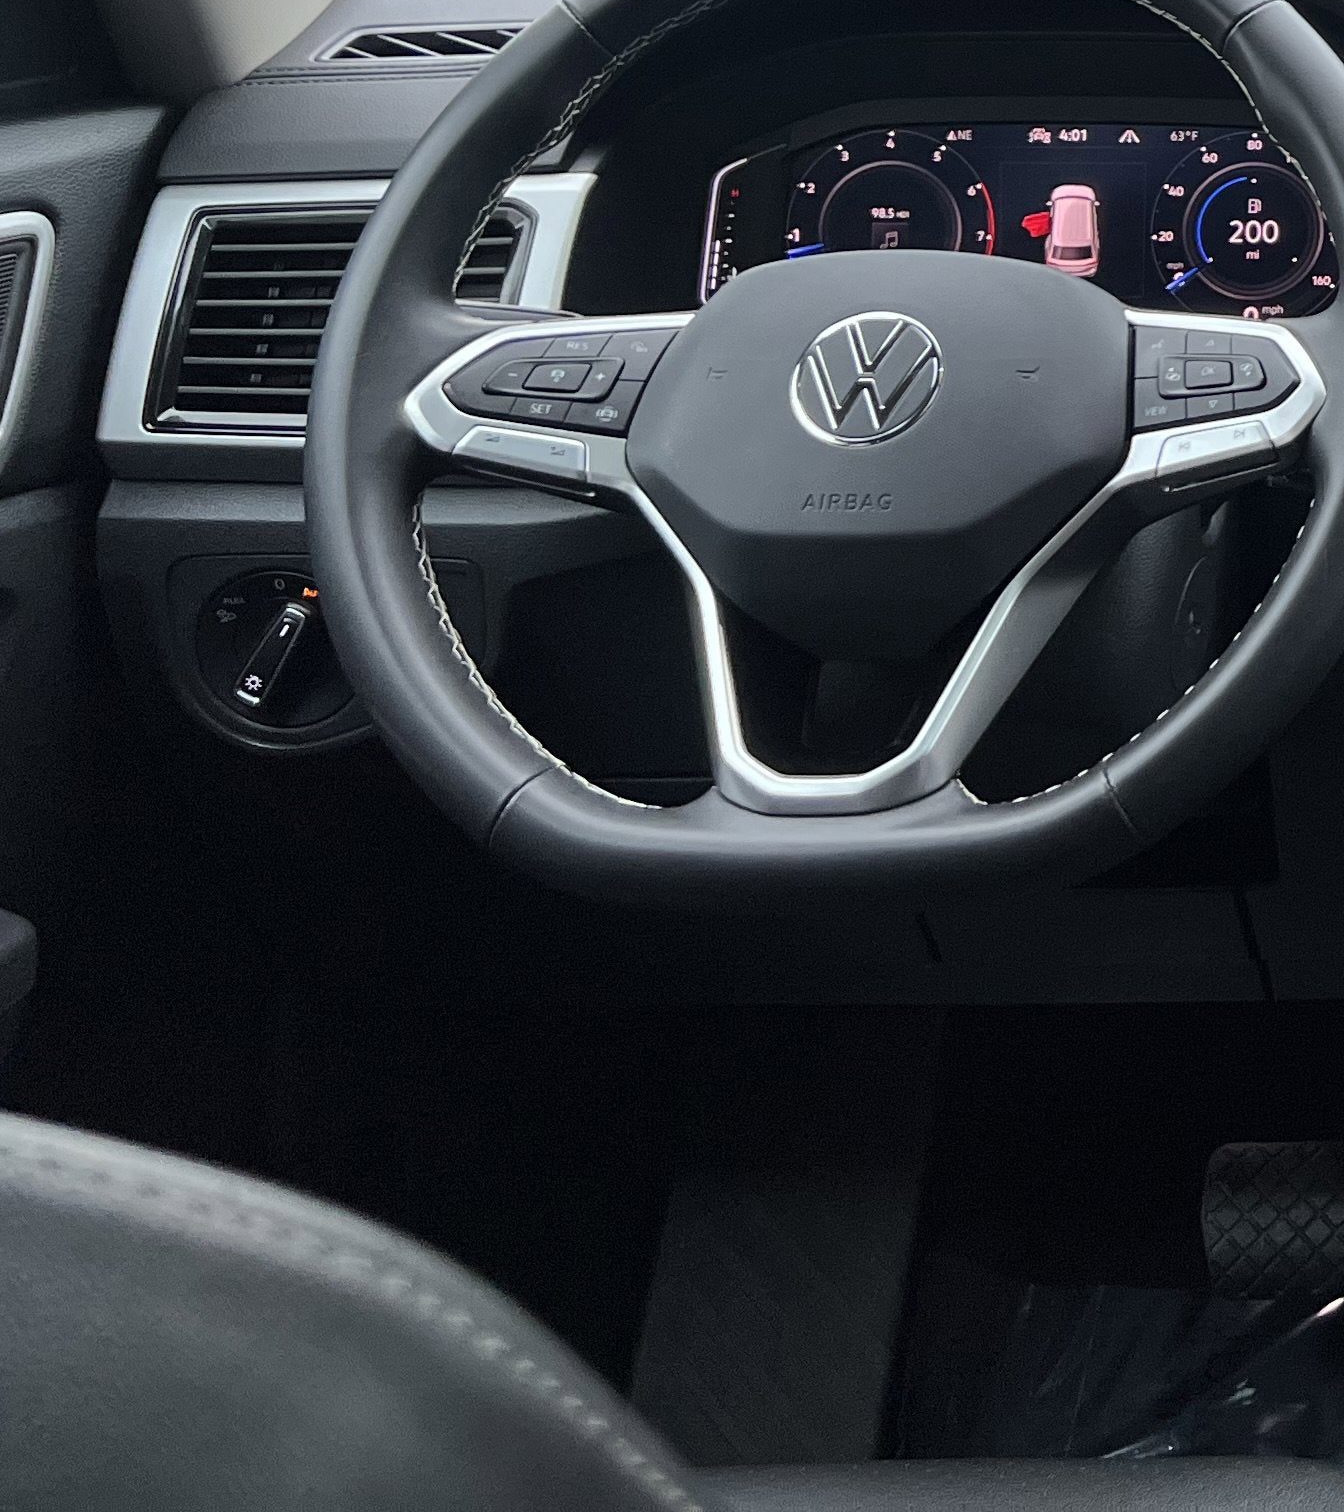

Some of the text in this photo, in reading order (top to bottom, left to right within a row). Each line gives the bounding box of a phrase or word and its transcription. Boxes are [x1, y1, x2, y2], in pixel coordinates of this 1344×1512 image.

[957, 129, 973, 140] NE
[1058, 128, 1087, 141] 4:01
[1170, 130, 1198, 141] 63°F
[886, 138, 895, 149] 4
[1246, 140, 1263, 151] 80
[840, 150, 849, 161] 3
[931, 150, 942, 162] 5
[1201, 152, 1218, 163] 60
[807, 182, 816, 194] 2
[966, 185, 977, 196] 6
[1167, 185, 1185, 197] 40
[871, 207, 895, 219] 98.5
[976, 230, 985, 242] 7
[1158, 231, 1174, 242] 20
[1228, 220, 1279, 244] 200
[1245, 249, 1260, 260] mi
[1311, 275, 1332, 286] 160
[1261, 304, 1284, 316] mph
[566, 341, 589, 352] RES
[1200, 366, 1216, 377] OK
[529, 402, 552, 414] SET
[1144, 405, 1168, 417] VIEW
[801, 492, 893, 511] AIRBAG
